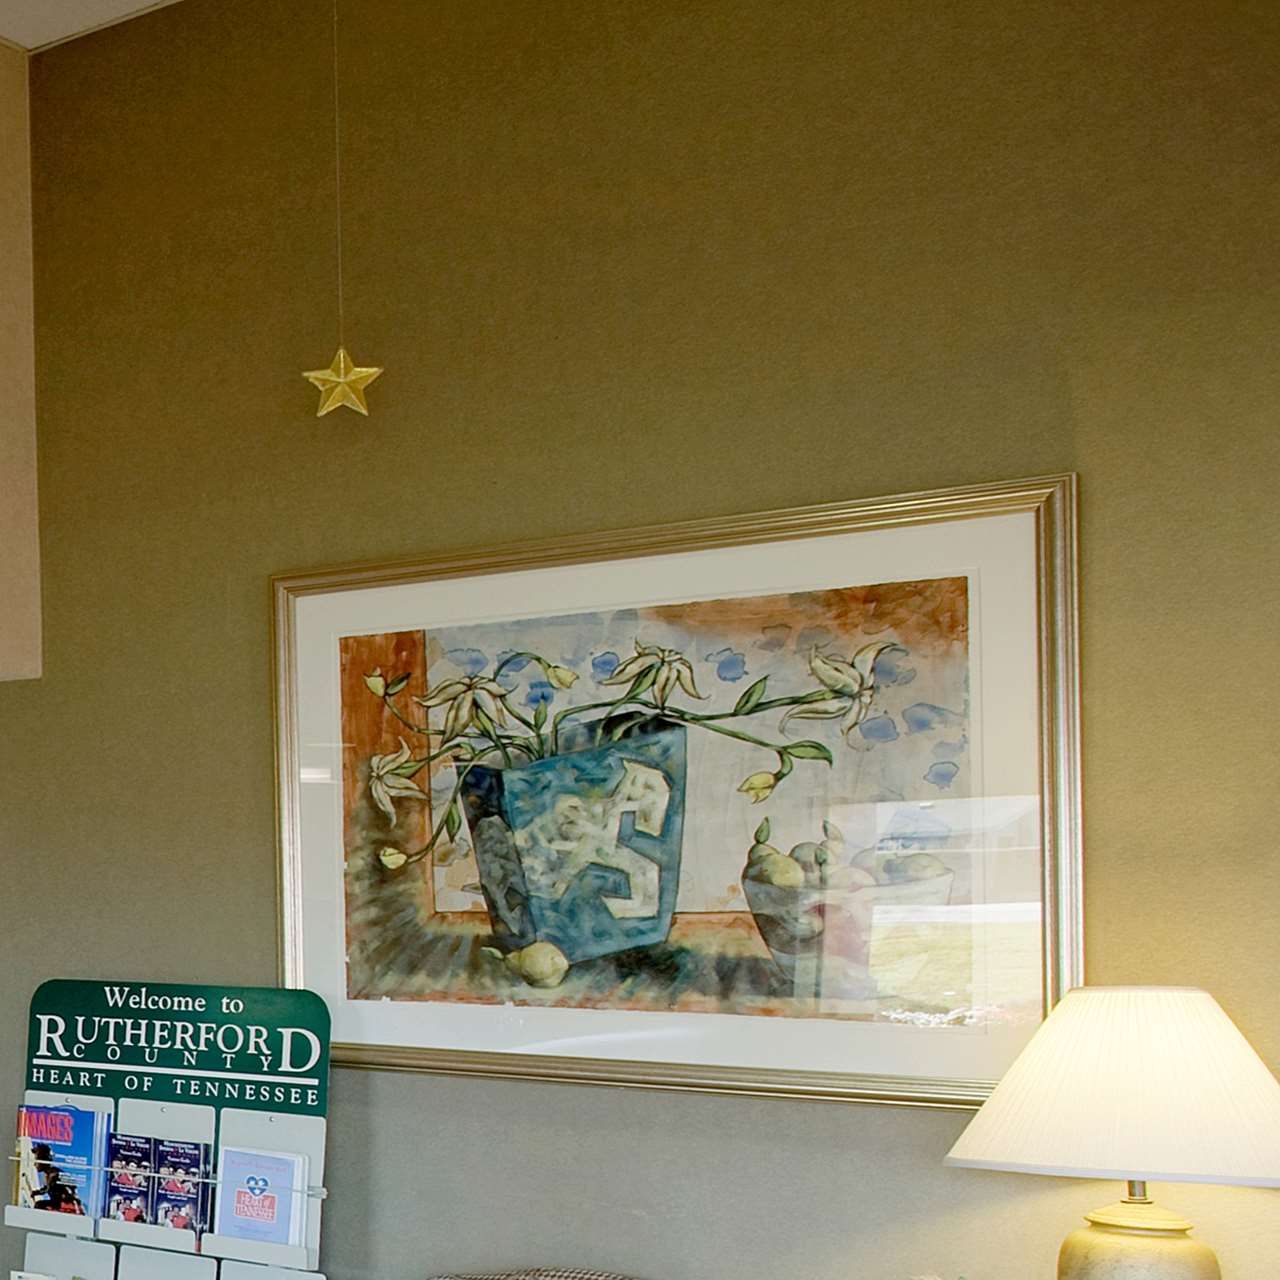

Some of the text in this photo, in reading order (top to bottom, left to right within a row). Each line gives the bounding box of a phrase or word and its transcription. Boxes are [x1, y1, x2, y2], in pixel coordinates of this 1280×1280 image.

[104, 986, 244, 1014] Welcome to
[35, 1014, 321, 1073] RUTHERFORD
[73, 1043, 273, 1071] COUNTY
[32, 1068, 319, 1106] HEART OF TENNESSEE
